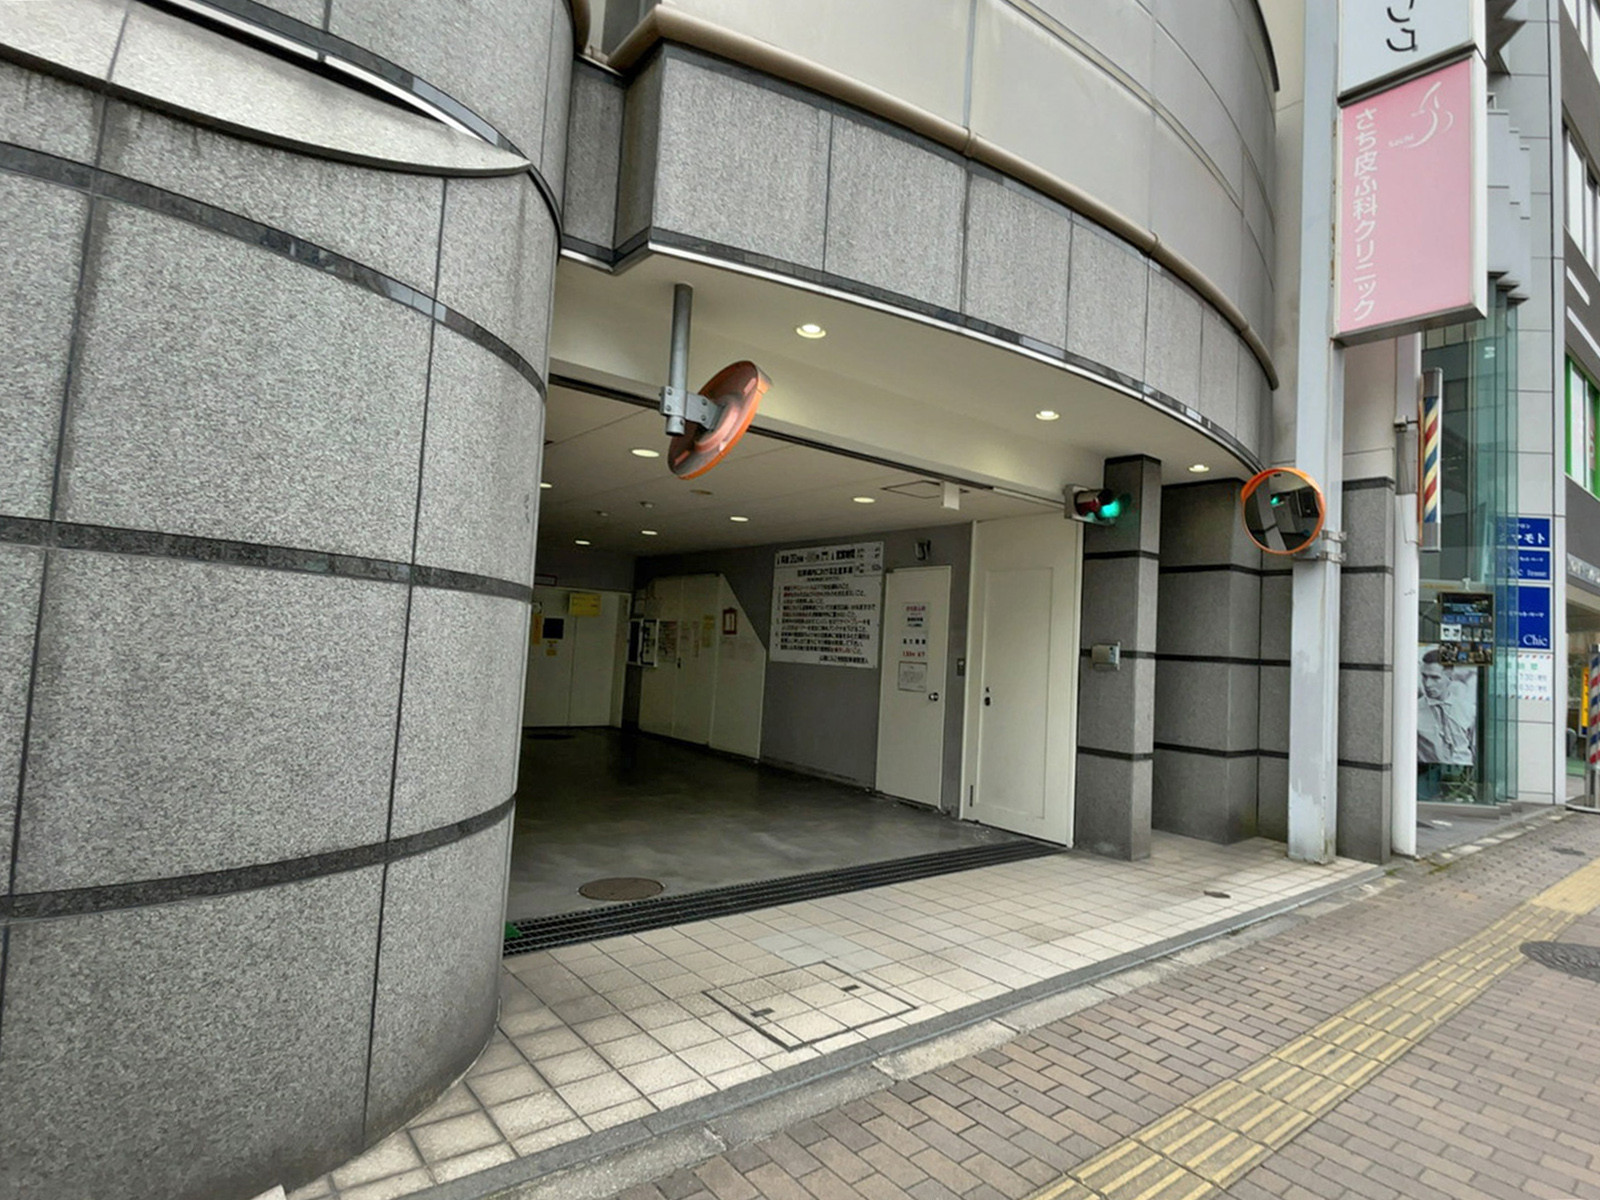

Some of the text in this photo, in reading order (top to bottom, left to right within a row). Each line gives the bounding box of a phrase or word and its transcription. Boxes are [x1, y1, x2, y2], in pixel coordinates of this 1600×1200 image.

[1352, 107, 1378, 322] さち皮ふ科クリニック
[1522, 633, 1549, 647] Chic
